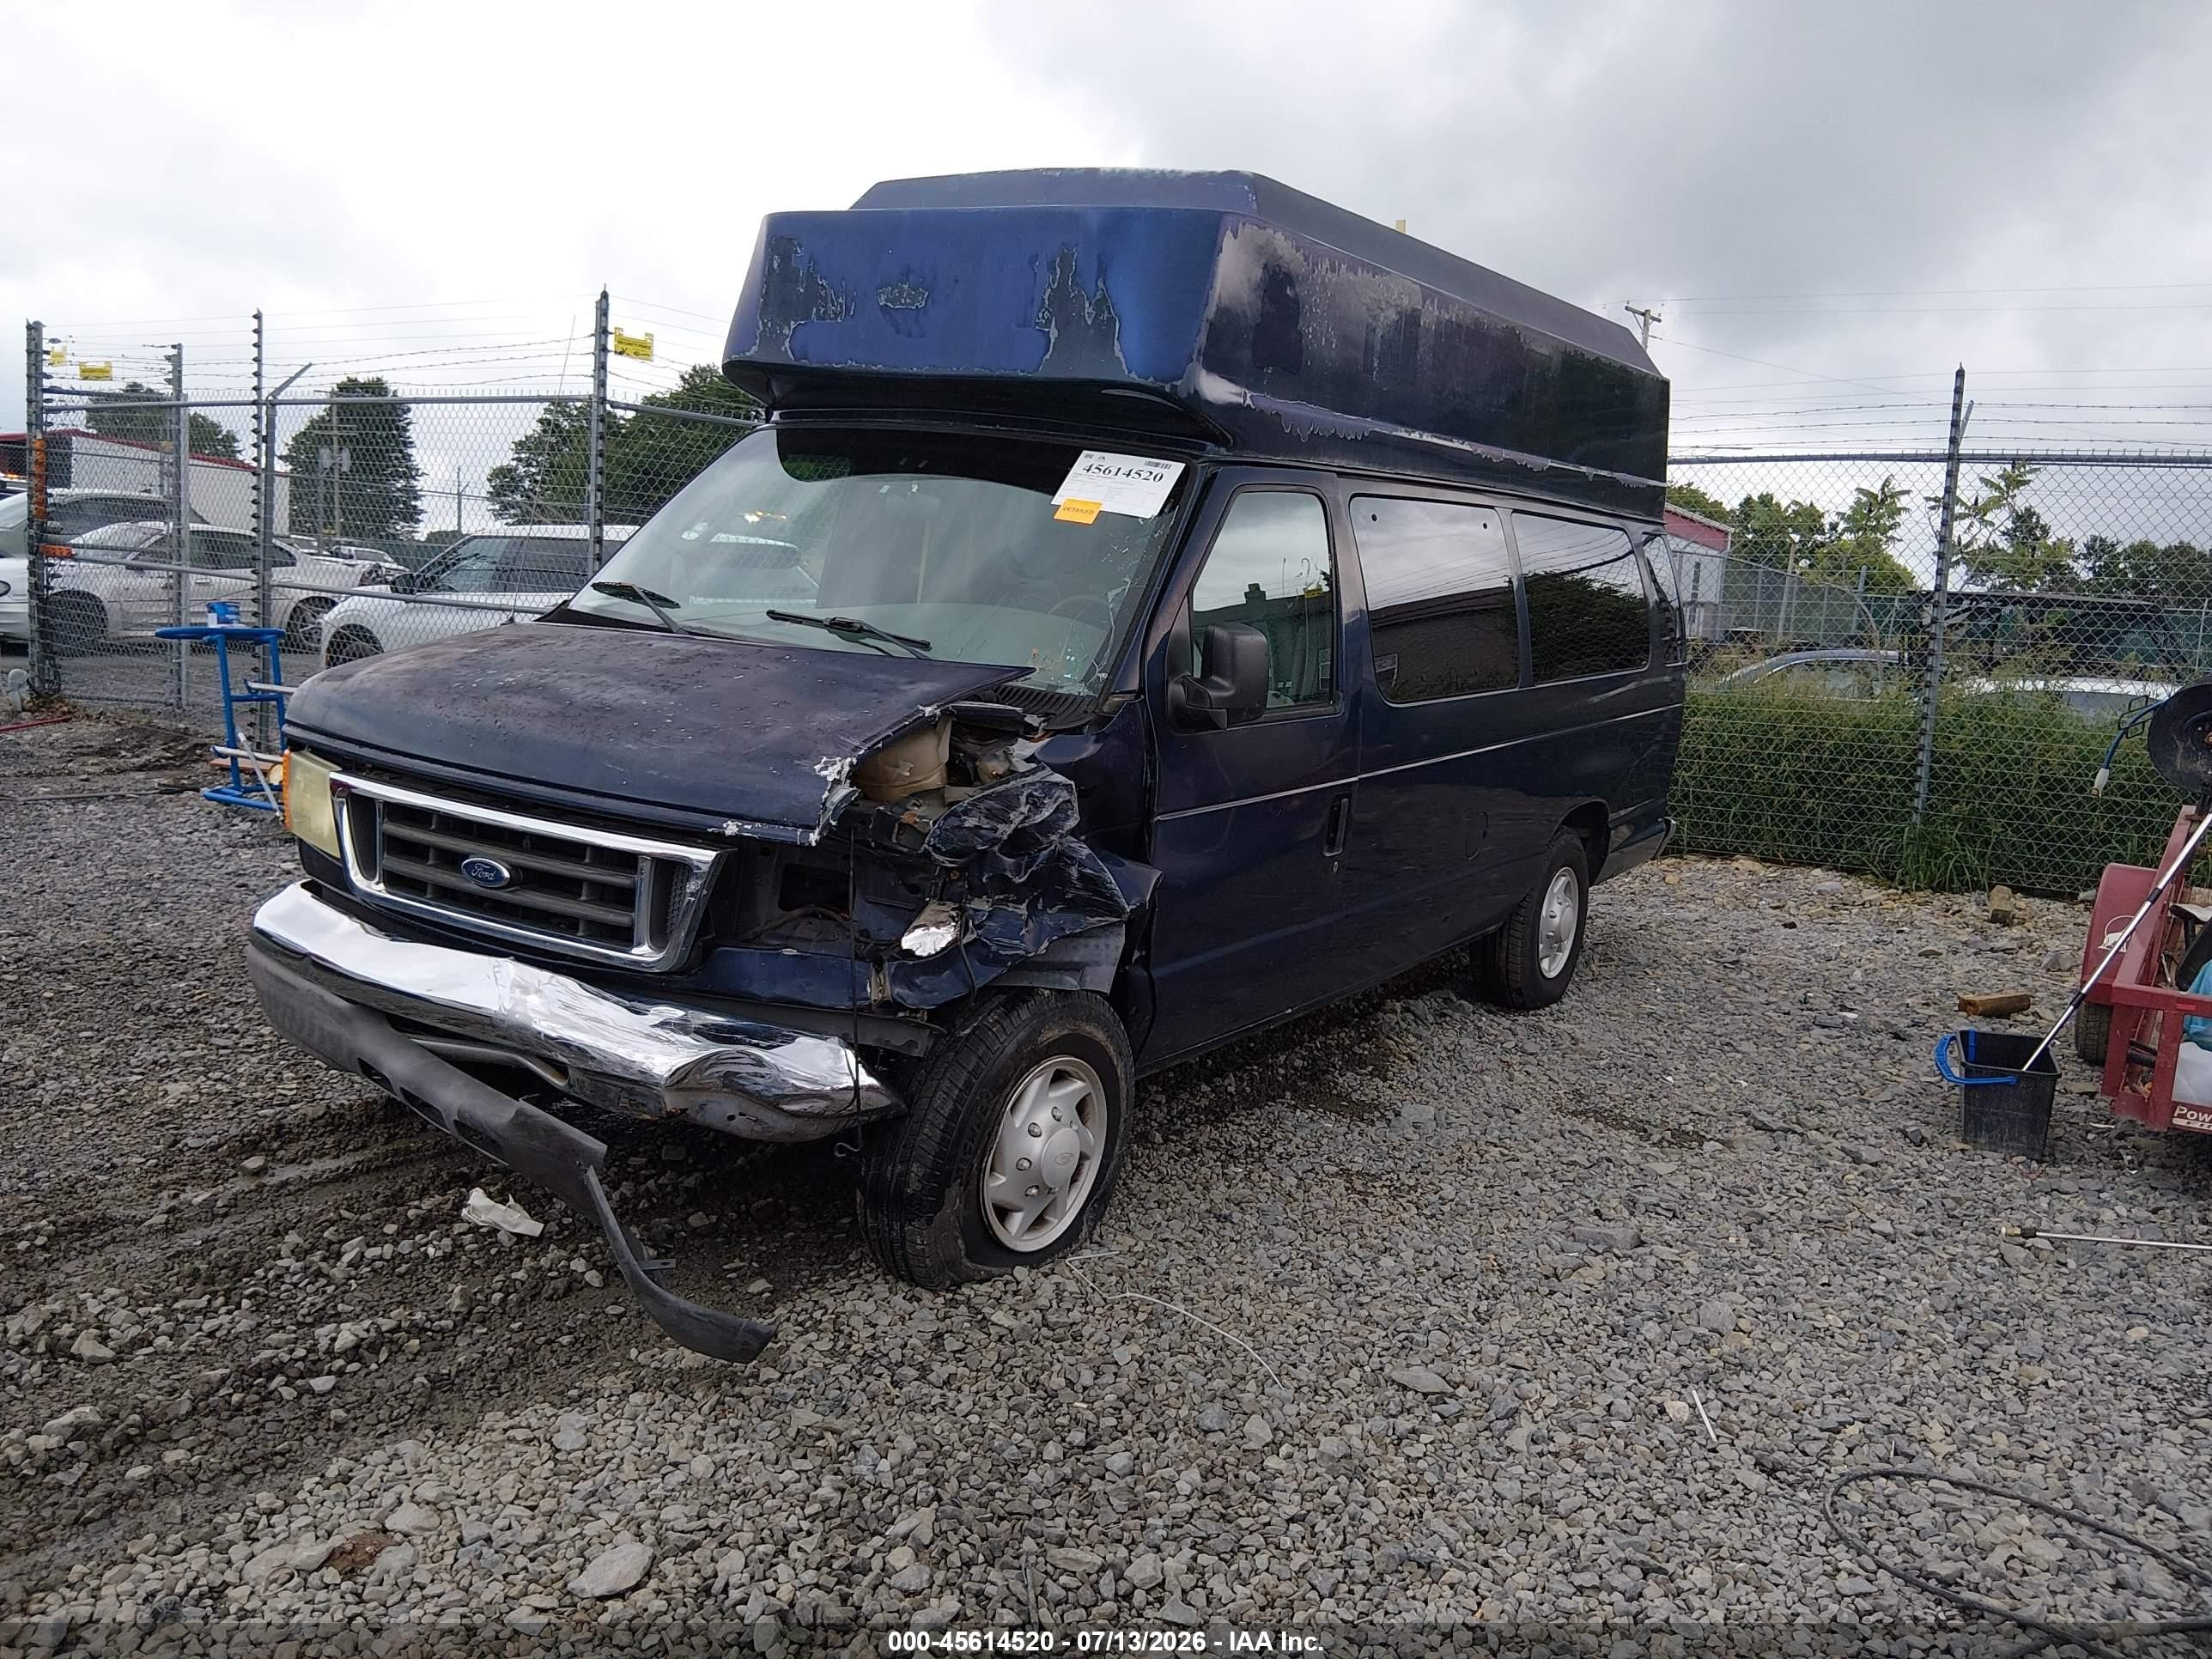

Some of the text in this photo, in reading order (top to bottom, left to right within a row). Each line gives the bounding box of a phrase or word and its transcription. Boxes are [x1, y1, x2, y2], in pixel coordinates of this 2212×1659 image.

[1082, 463, 1164, 483] 45614520
[1062, 506, 1095, 515] DETAILED
[471, 862, 496, 880] Ford
